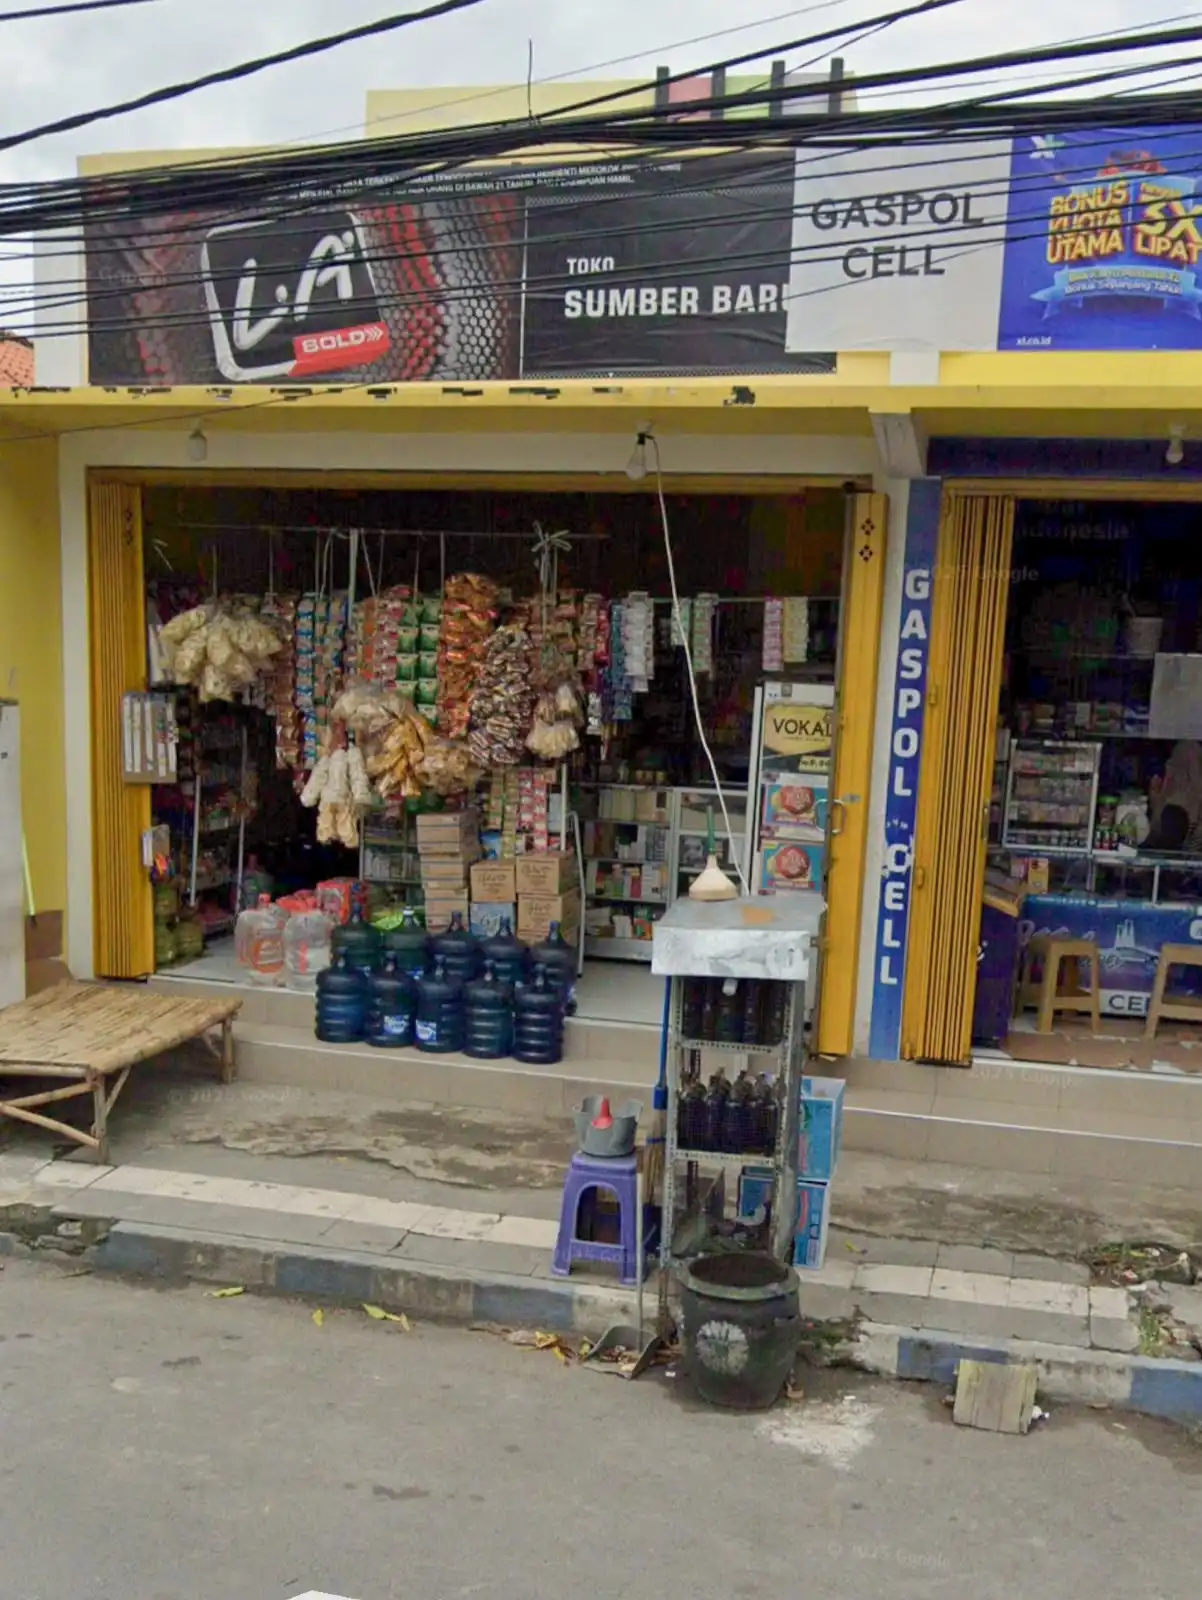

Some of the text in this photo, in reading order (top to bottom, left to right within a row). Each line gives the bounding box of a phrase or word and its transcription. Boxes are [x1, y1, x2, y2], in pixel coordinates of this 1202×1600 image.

[811, 191, 985, 231] GASPOL
[1050, 181, 1128, 215] BONUS
[842, 243, 946, 279] CELL
[1046, 228, 1124, 264] UTAMA
[1134, 231, 1202, 265] LIPAT
[564, 285, 700, 319] SUMBER
[301, 329, 366, 354] BOLD
[893, 568, 931, 798] GASPOL
